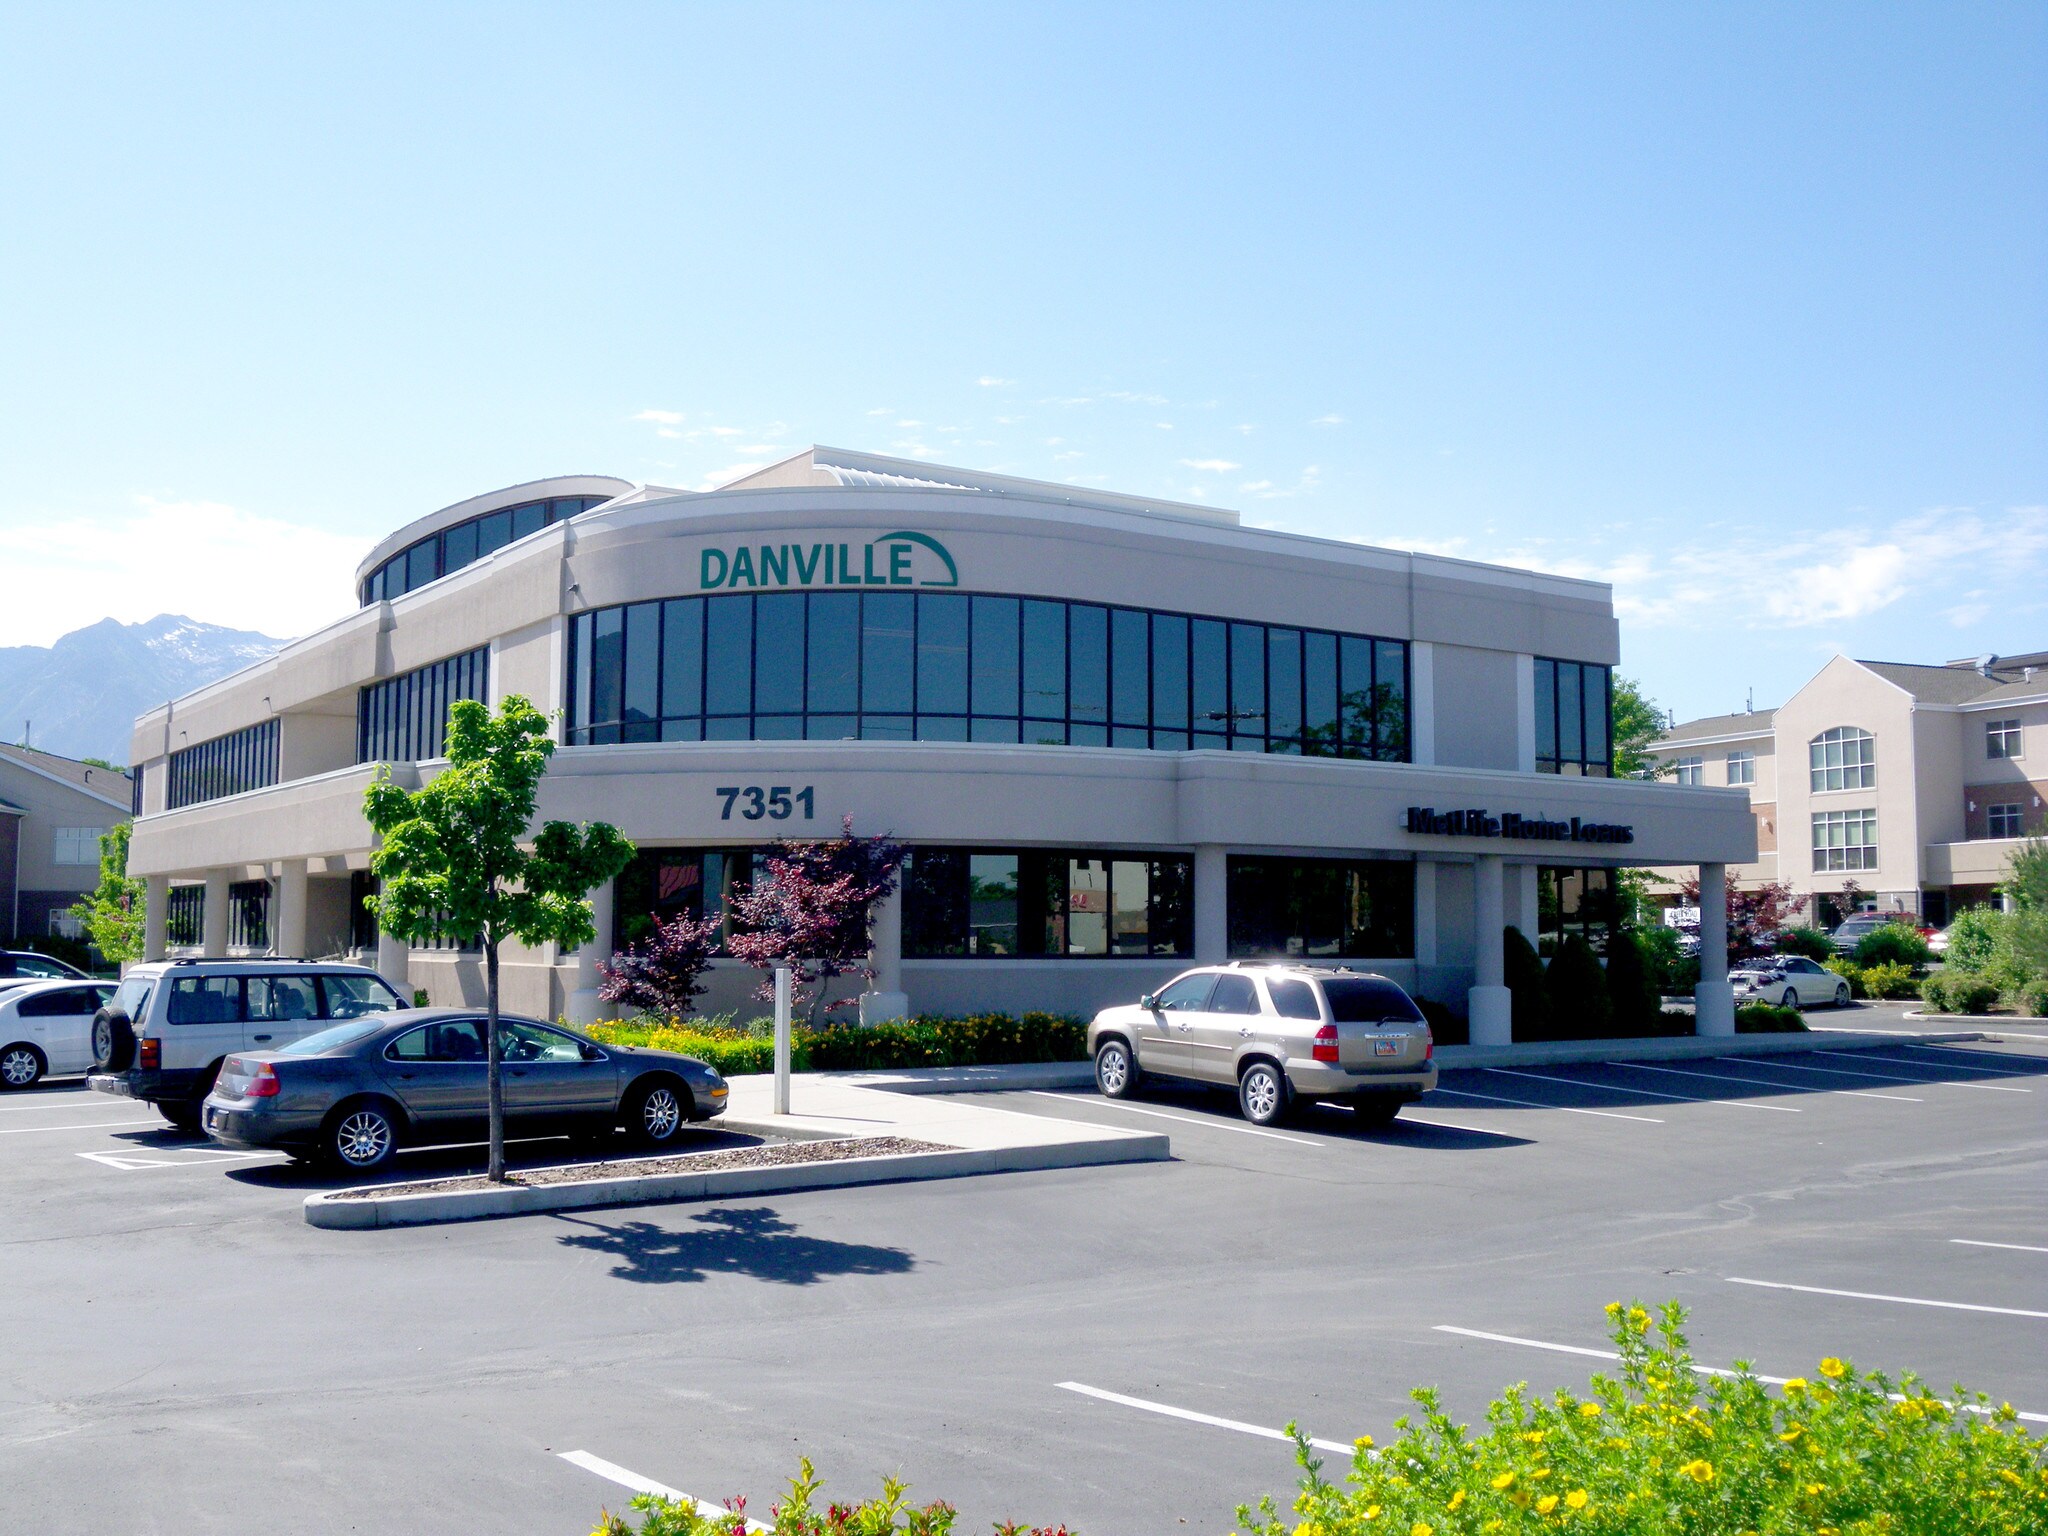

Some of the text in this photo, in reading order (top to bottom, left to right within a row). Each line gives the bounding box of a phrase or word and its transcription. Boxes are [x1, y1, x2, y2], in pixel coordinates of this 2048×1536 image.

[700, 543, 913, 590] DANVILLE
[716, 785, 815, 820] 7351
[1502, 812, 1570, 842] Home
[1571, 817, 1635, 845] Loans
